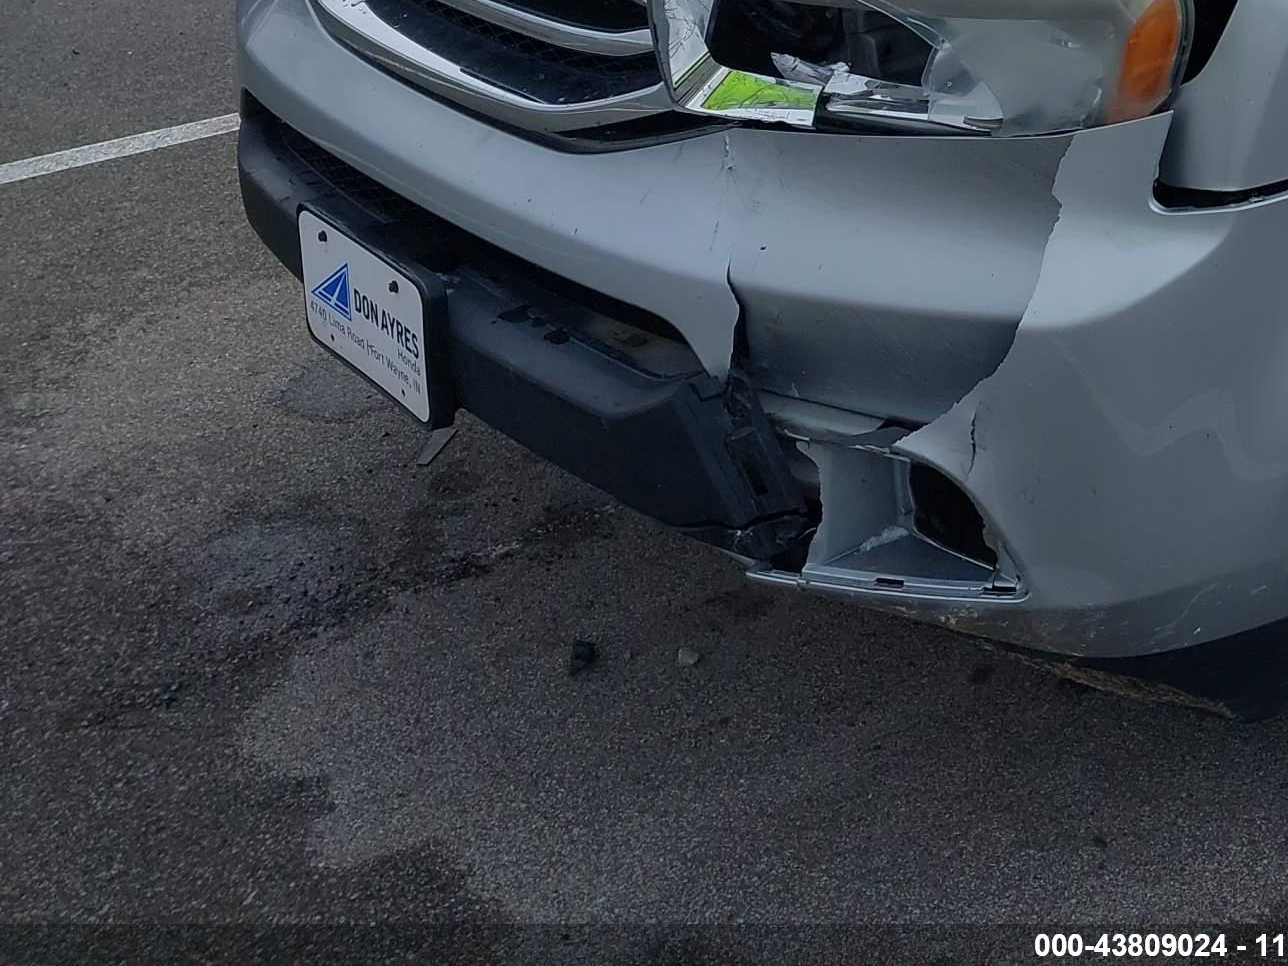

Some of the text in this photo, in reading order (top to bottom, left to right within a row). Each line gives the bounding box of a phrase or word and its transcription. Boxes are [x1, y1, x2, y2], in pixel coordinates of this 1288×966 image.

[328, 313, 346, 335] Lima
[346, 325, 365, 350] Road
[353, 287, 419, 360] DON AYRES
[397, 347, 421, 377] Honda
